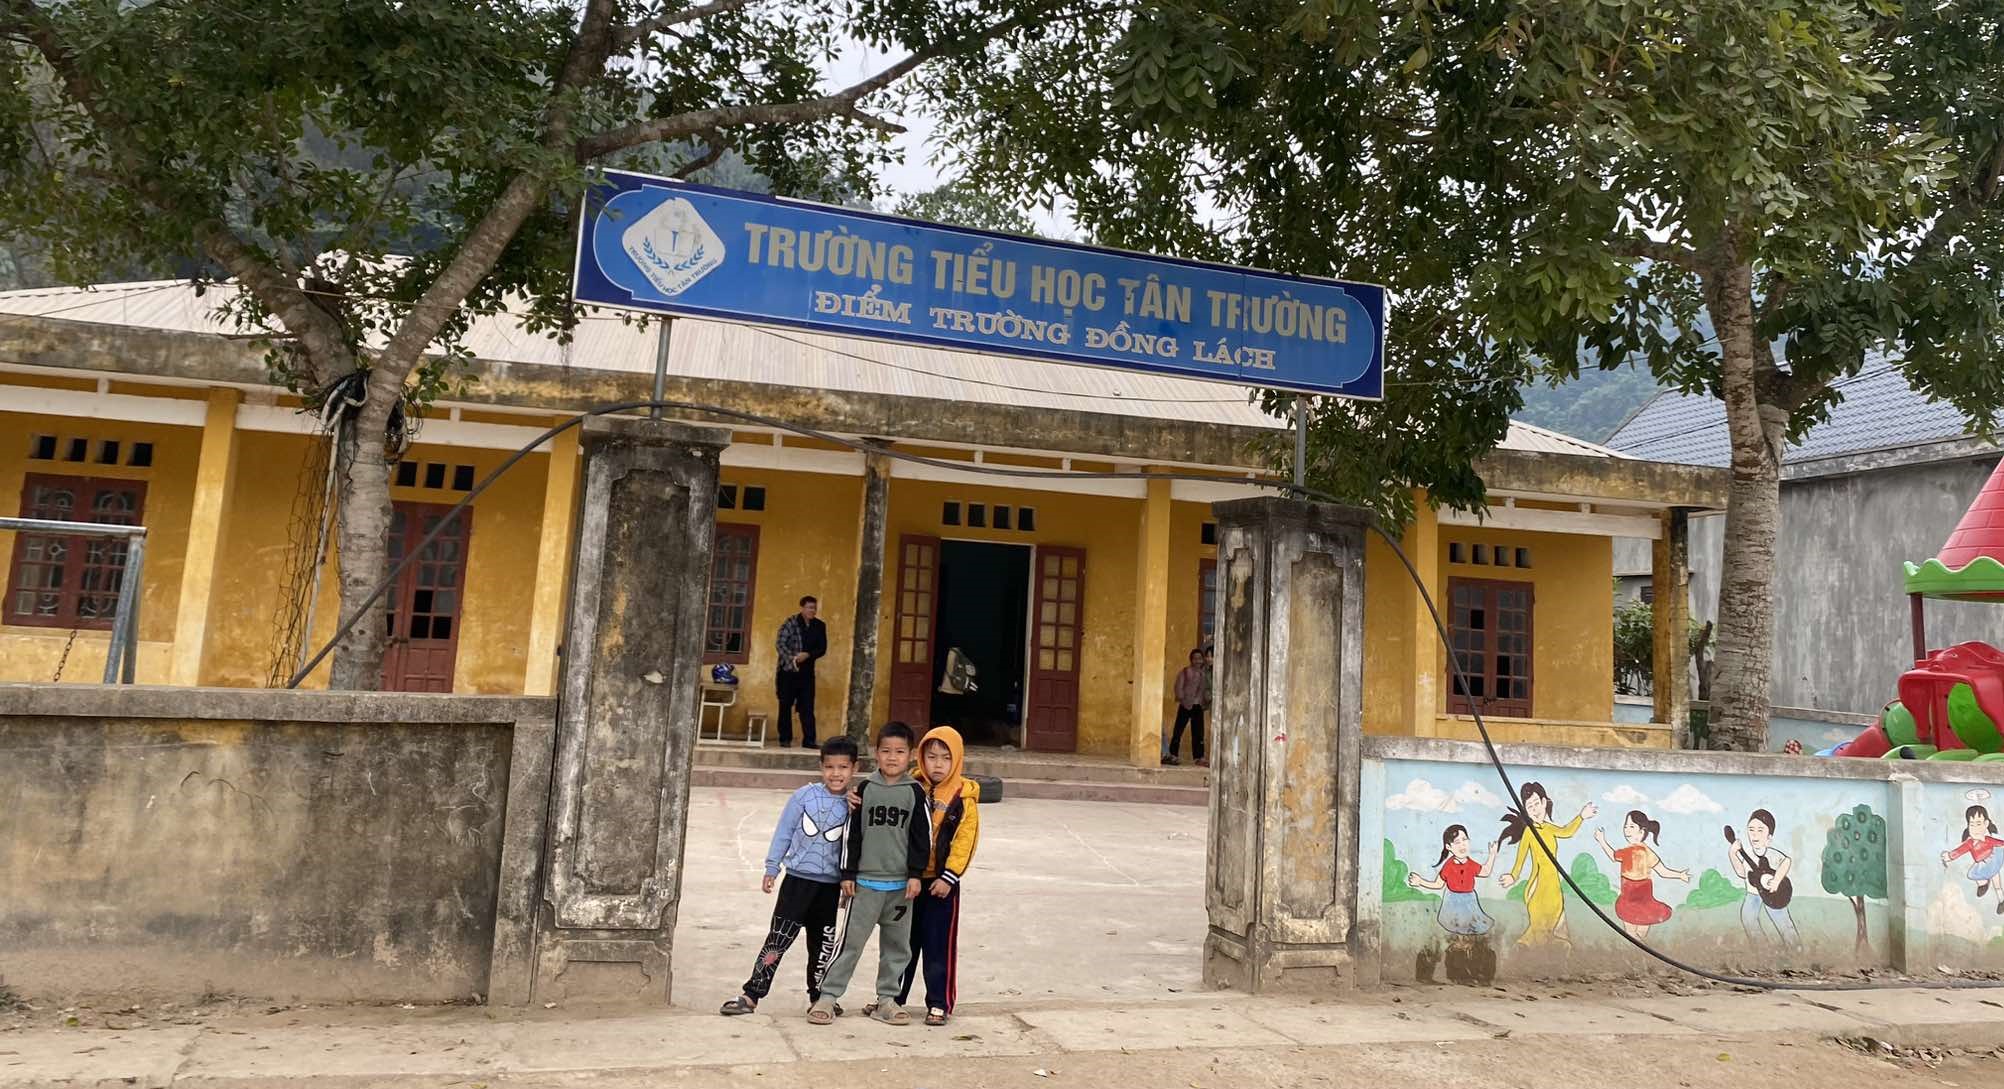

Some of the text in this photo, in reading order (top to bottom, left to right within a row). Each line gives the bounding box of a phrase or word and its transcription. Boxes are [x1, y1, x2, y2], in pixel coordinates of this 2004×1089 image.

[744, 222, 1348, 345] TRƯỜNG TIỂU HỌC TÂN TRƯỜNG
[814, 283, 1277, 371] ĐIỂM TRƯỜNG ĐỒNG LÁCH
[868, 805, 910, 829] 1997
[893, 905, 907, 921] 7
